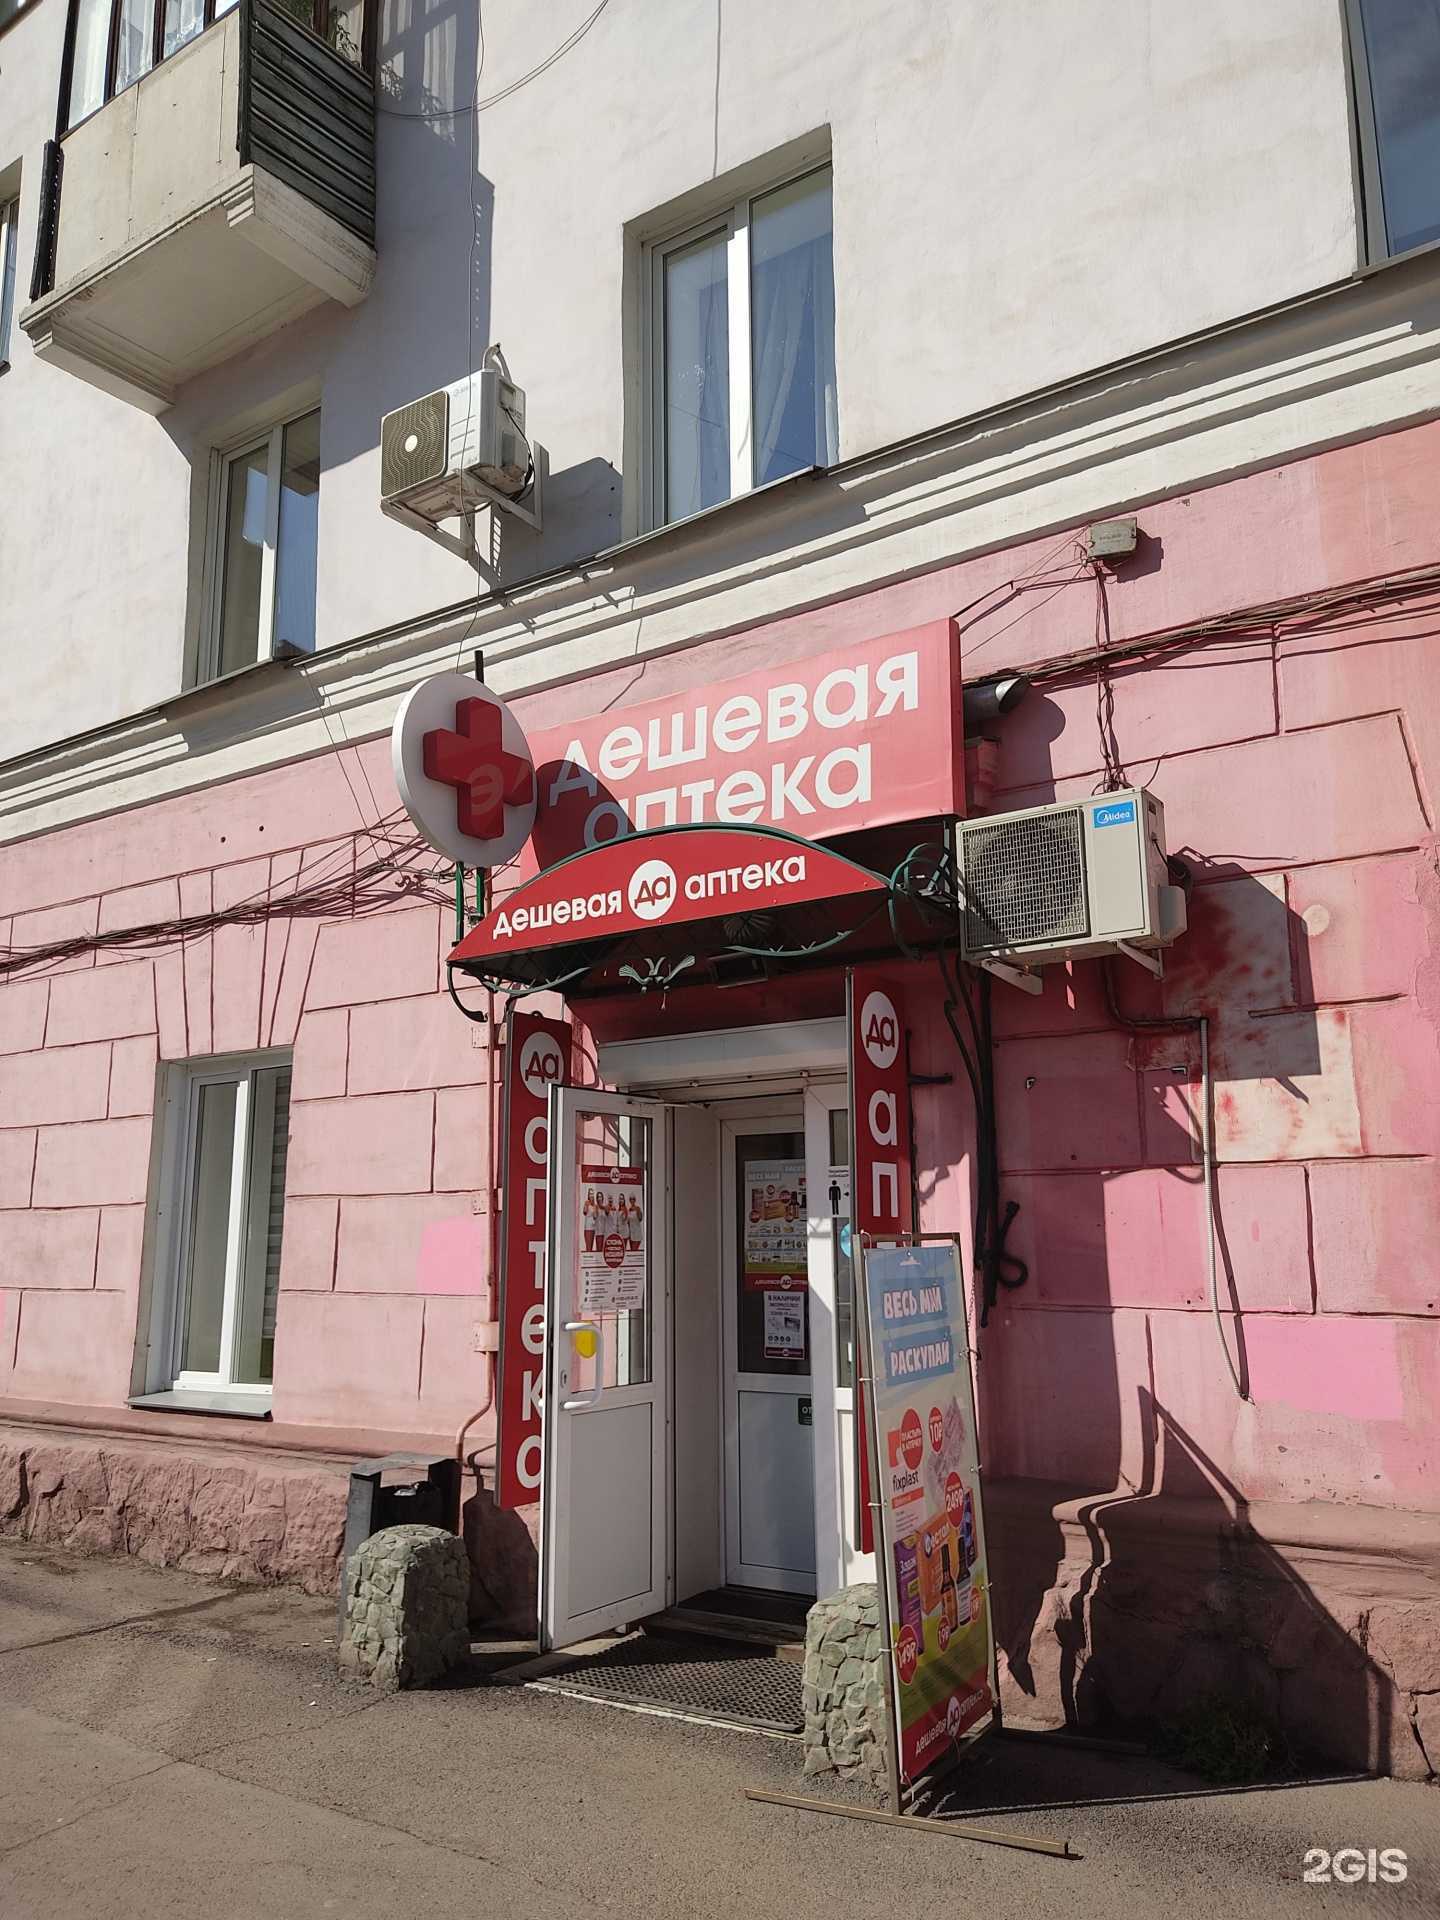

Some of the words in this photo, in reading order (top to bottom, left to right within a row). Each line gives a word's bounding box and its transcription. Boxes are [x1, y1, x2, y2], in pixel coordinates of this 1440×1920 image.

[585, 742, 872, 848] аптека
[1100, 811, 1130, 822] Midea
[684, 855, 806, 901] аптека
[883, 1289, 917, 1320] ВЕСЬ
[893, 1471, 919, 1492] fixplast
